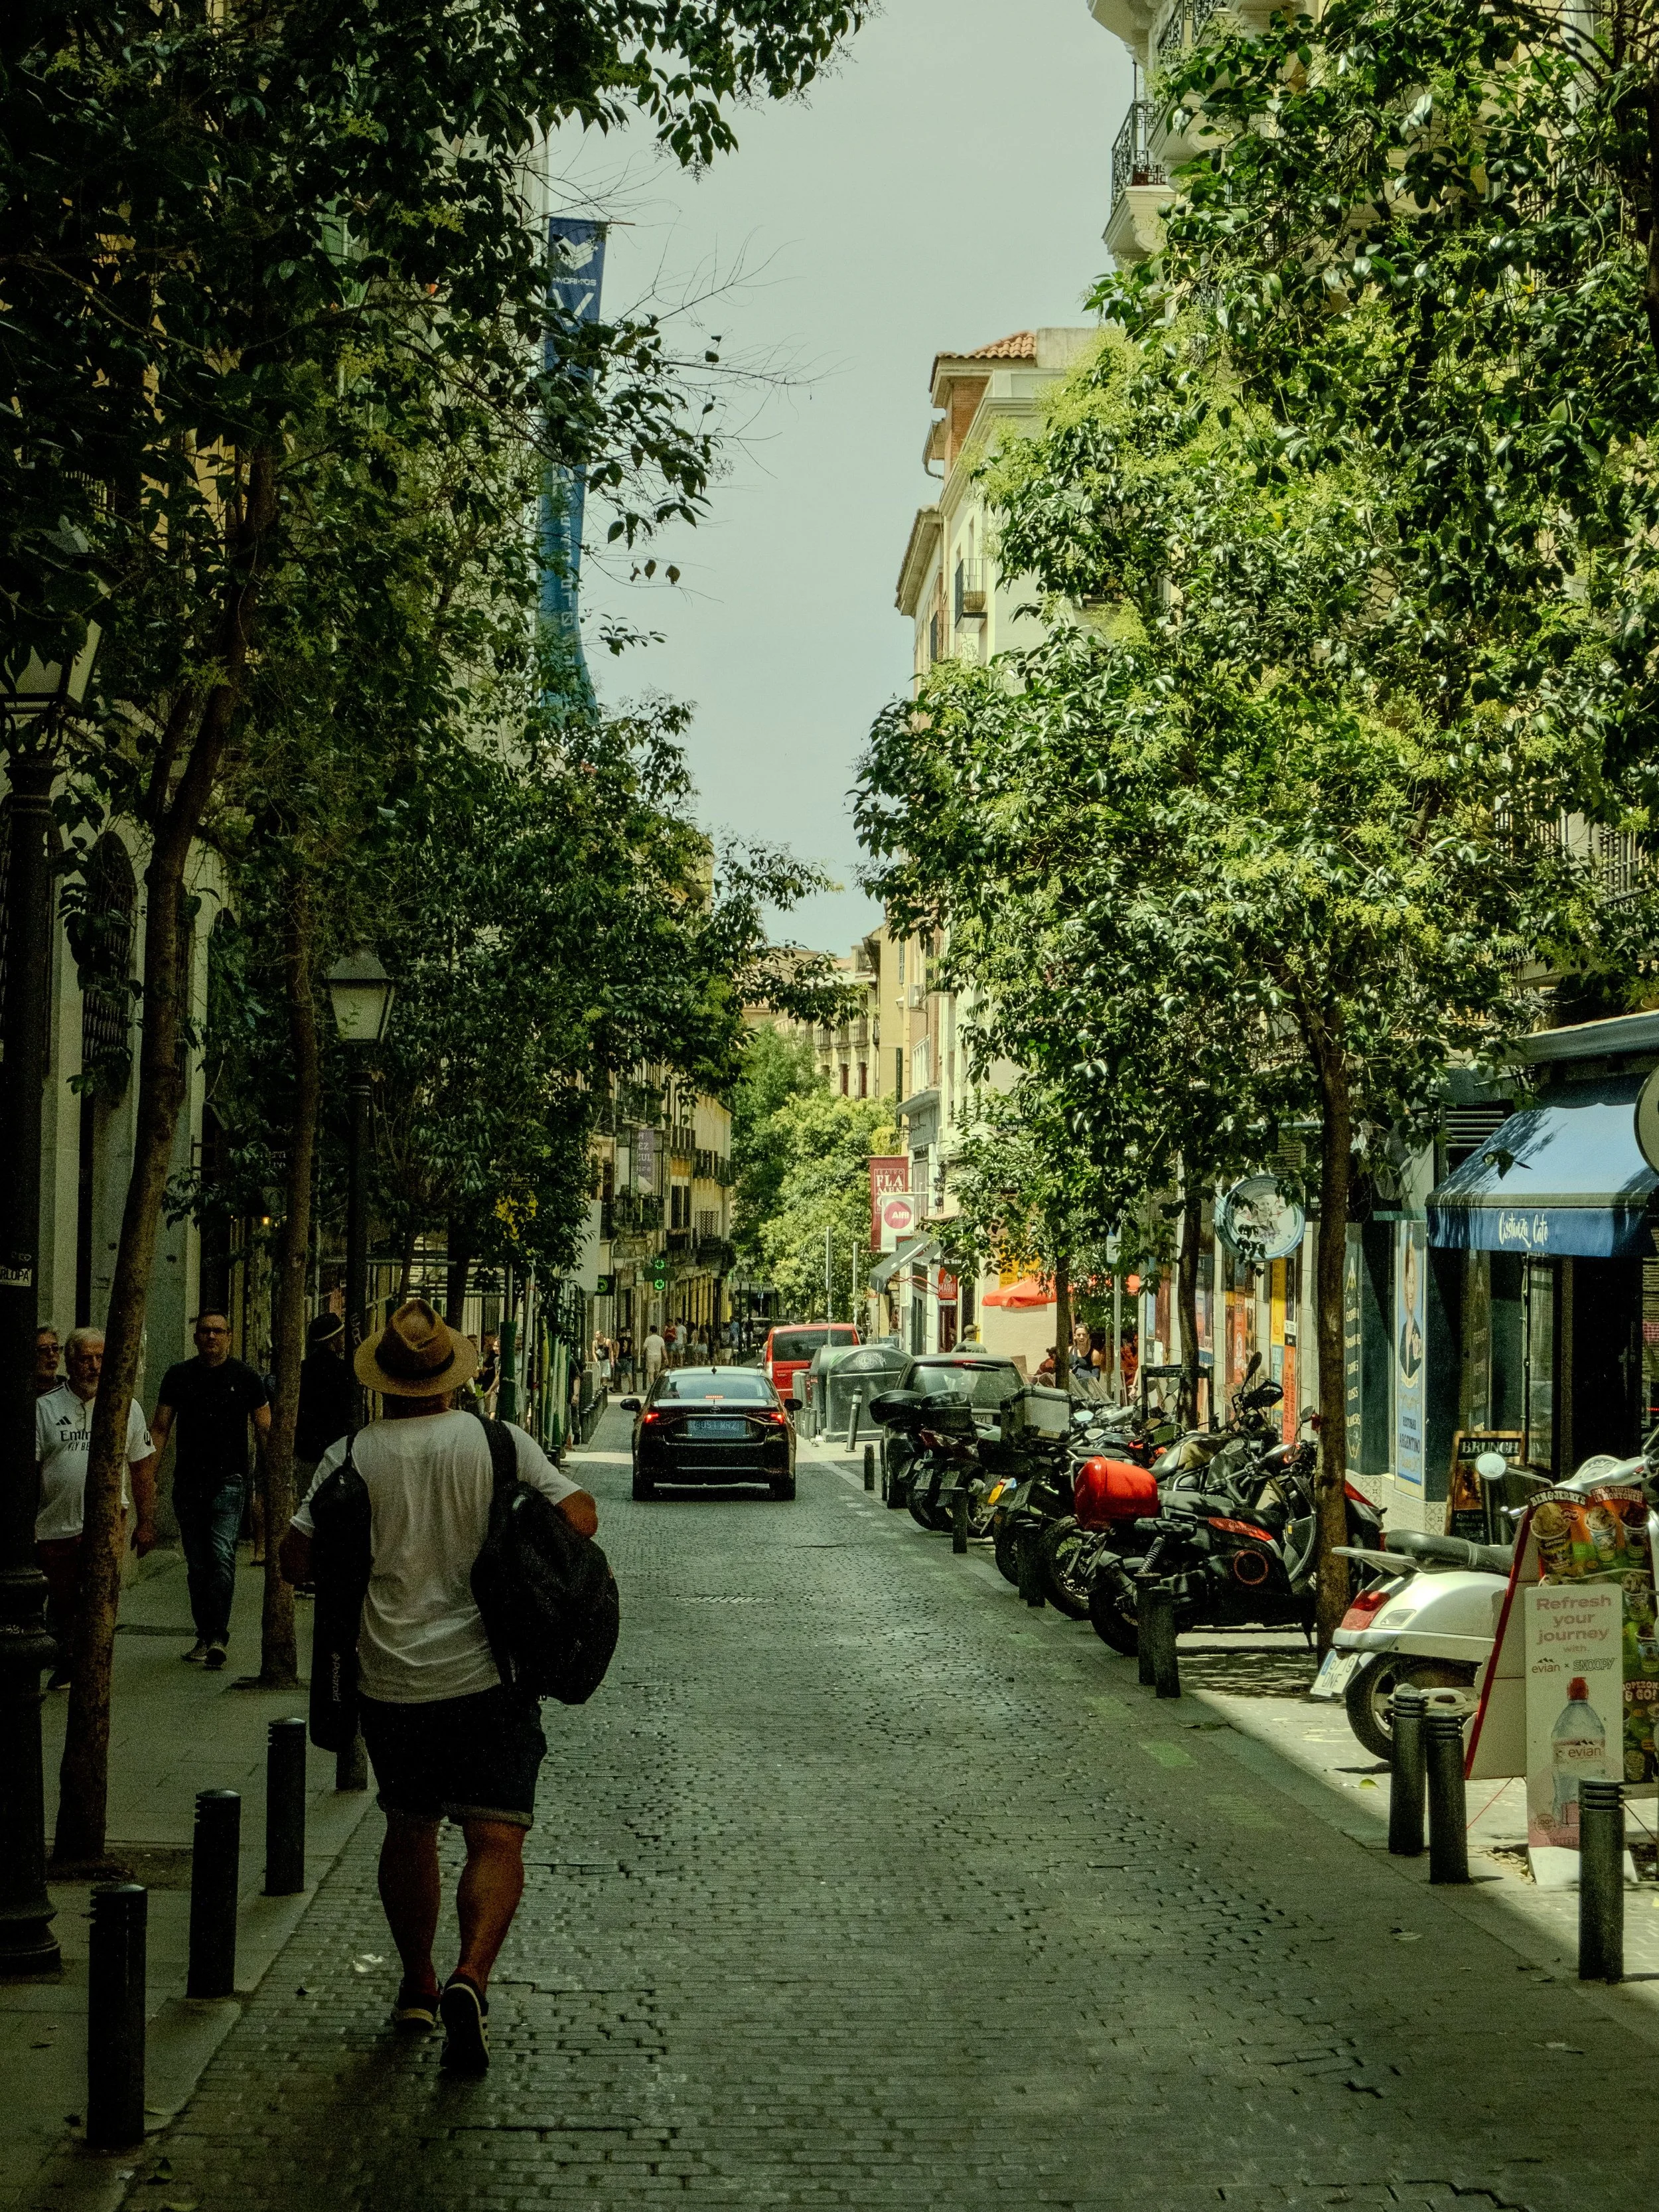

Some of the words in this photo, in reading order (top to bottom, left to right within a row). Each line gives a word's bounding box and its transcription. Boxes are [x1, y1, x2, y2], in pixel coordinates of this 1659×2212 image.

[875, 1175, 904, 1187] FLA
[1461, 1441, 1520, 1453] BRUNCH
[1536, 1595, 1612, 1611] Refresh
[1553, 1613, 1595, 1628] your
[1536, 1629, 1610, 1645] journey
[1532, 1663, 1561, 1674] evian
[1573, 1657, 1615, 1672] SNOOPY
[1636, 1688, 1657, 1701] GO!
[1568, 1746, 1602, 1758] evian
